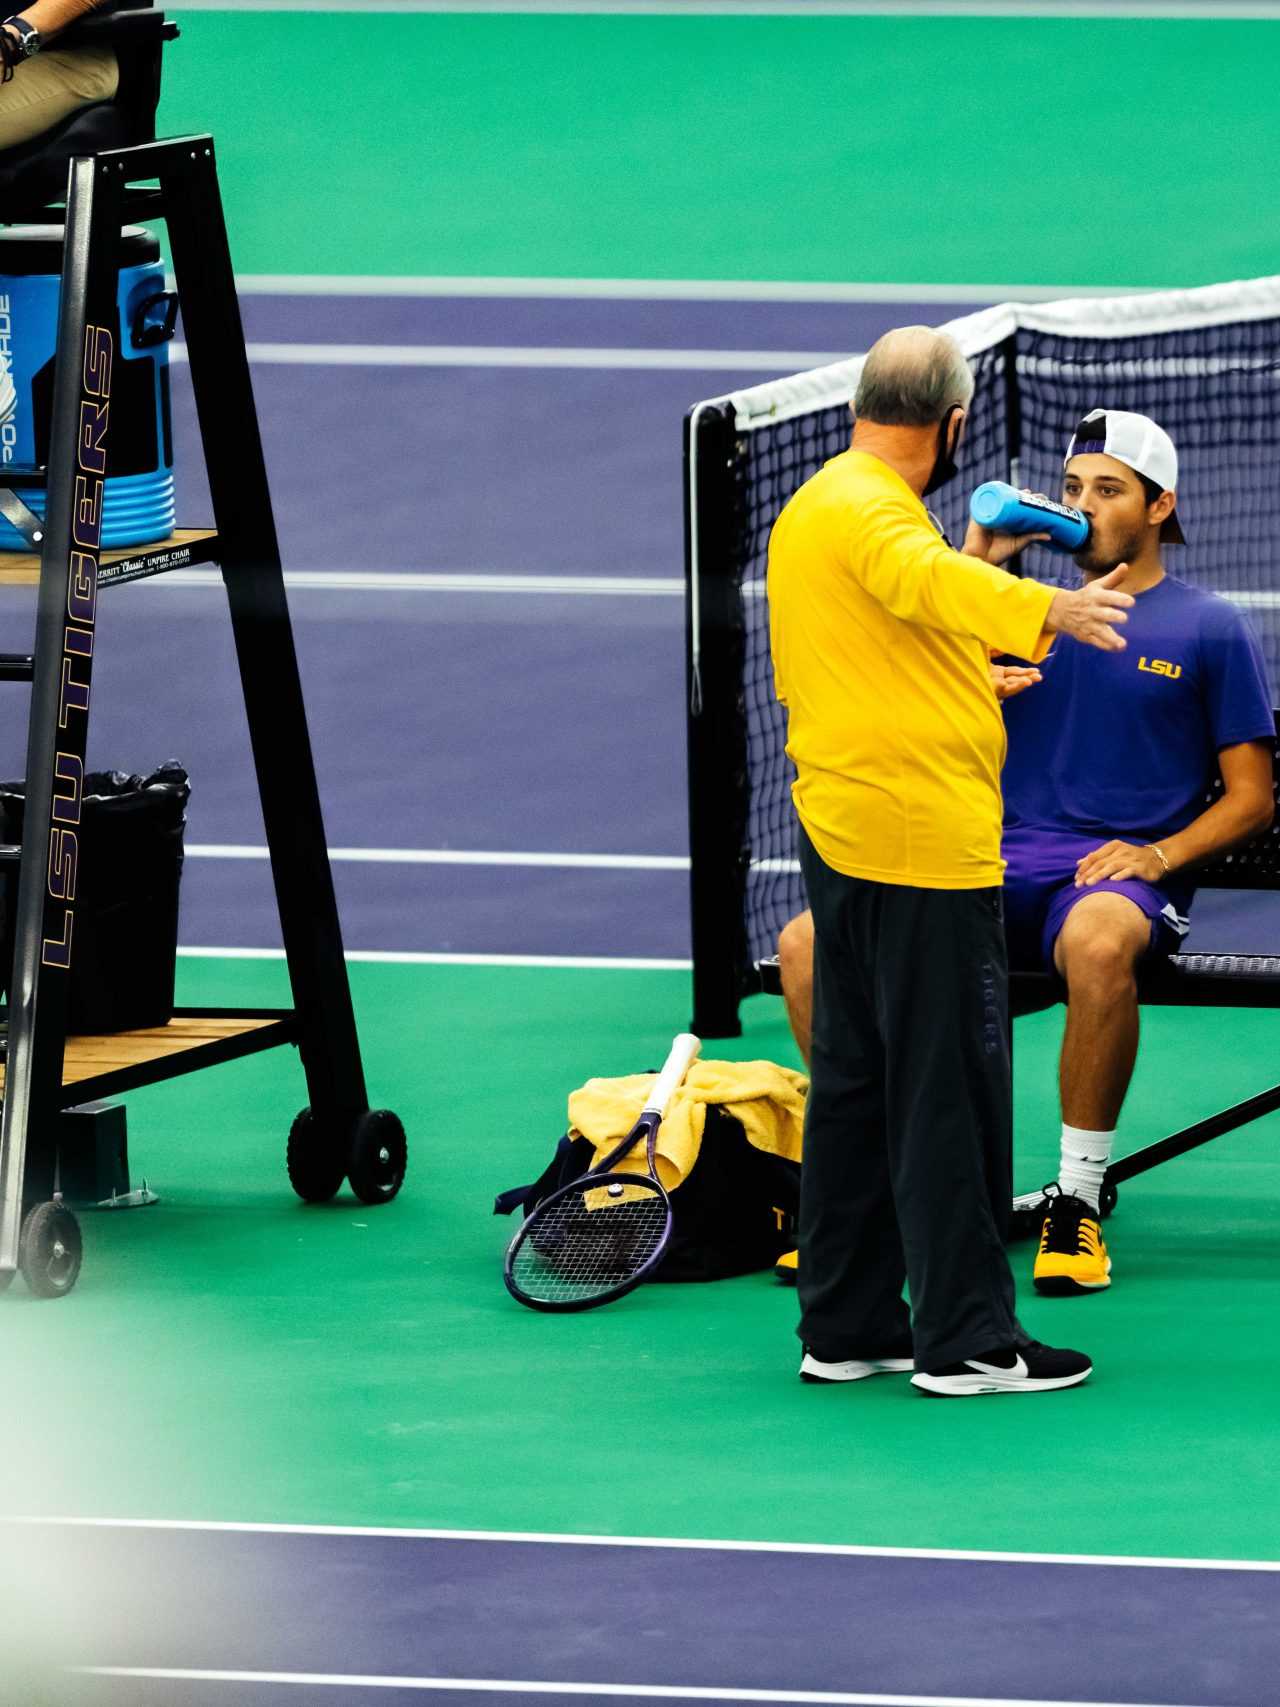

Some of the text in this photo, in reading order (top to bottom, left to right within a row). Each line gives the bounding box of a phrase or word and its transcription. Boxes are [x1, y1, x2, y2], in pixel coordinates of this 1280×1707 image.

[98, 565, 120, 579] ERRITT
[147, 553, 169, 567] UMPIRE
[171, 548, 190, 561] CHAIR
[42, 324, 113, 969] LSU TIGERS
[1137, 656, 1182, 679] LSU
